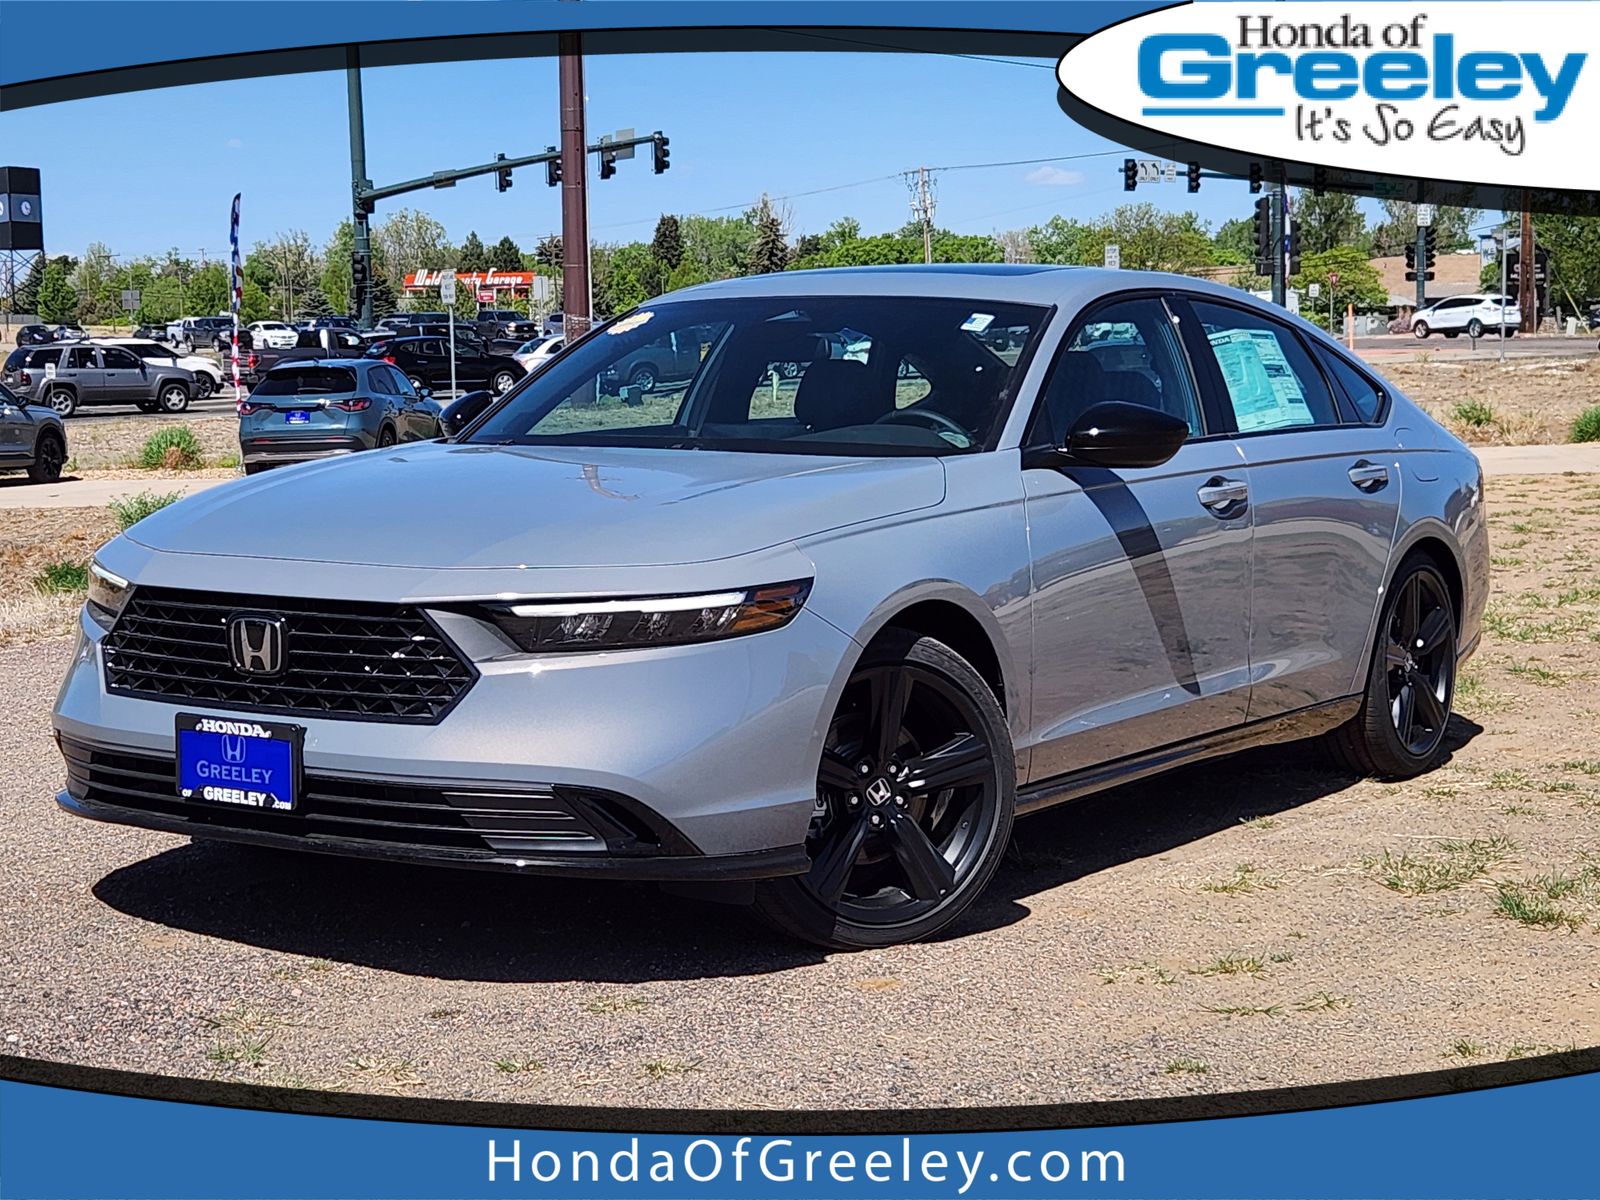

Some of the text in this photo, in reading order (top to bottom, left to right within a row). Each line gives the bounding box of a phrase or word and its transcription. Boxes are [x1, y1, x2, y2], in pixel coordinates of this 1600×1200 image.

[201, 718, 266, 738] HONDA
[196, 760, 272, 784] GREELEY
[203, 786, 267, 807] GREELEY
